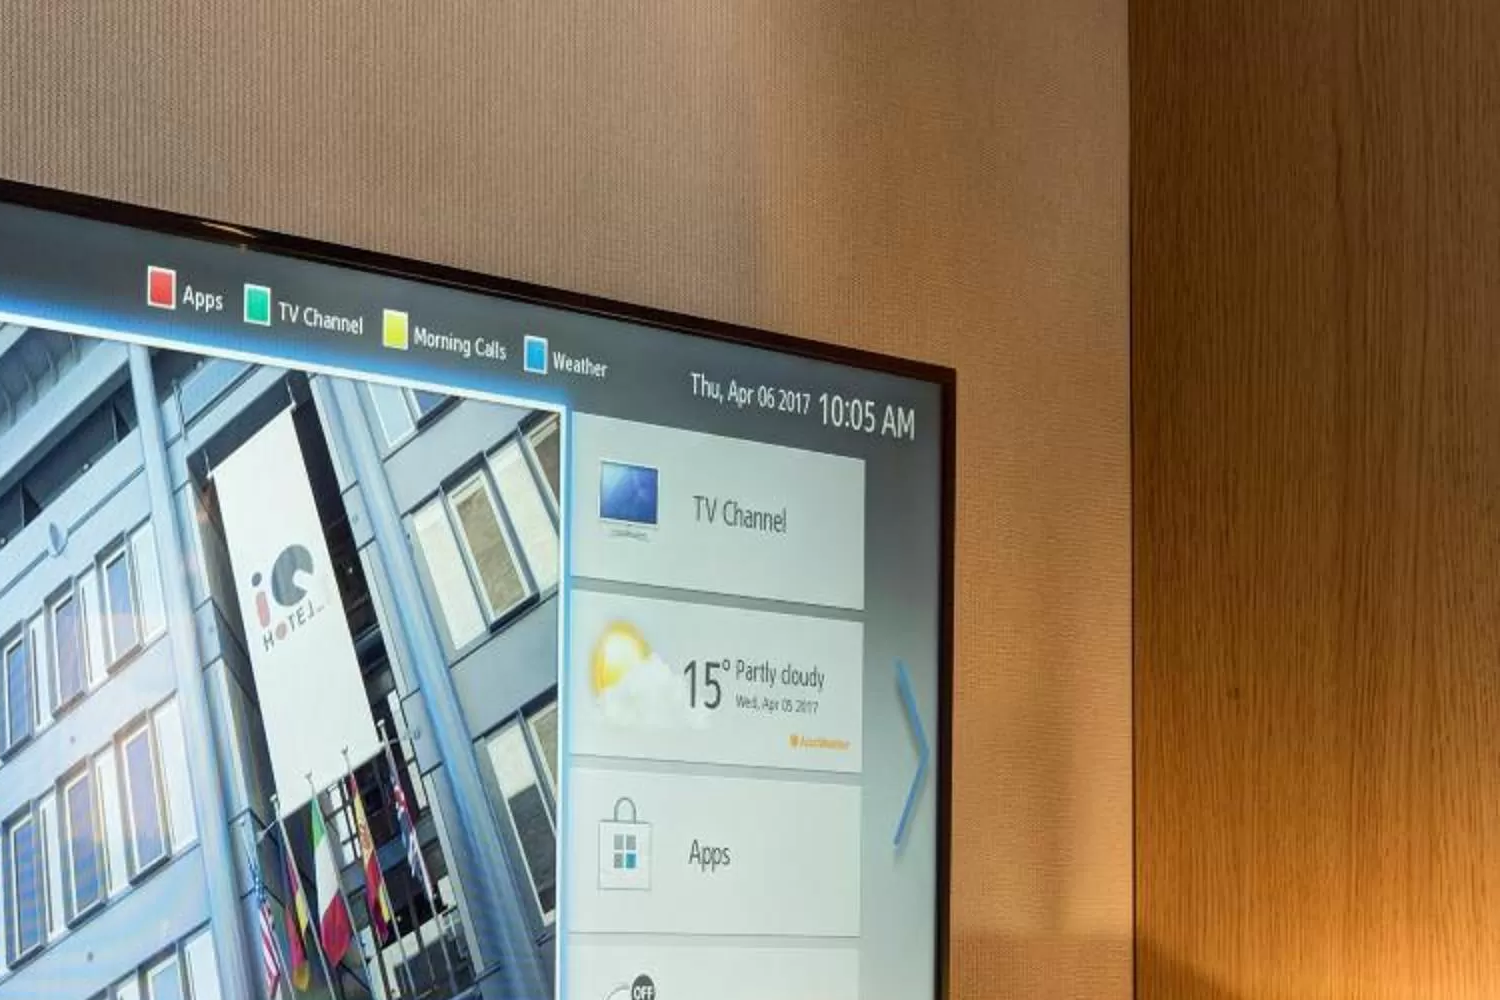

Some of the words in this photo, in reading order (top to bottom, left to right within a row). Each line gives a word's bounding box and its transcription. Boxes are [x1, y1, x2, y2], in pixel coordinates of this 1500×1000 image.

[182, 284, 223, 313] Apps
[278, 301, 299, 324] TV
[303, 306, 363, 336] Channel
[413, 326, 471, 359] Morning
[475, 338, 507, 362] Calls
[552, 351, 608, 378] Weather
[691, 372, 723, 405] Thu,
[727, 382, 754, 409] Apr
[758, 385, 775, 409] 06
[778, 388, 811, 416] 2017
[818, 393, 875, 434] 10:05
[881, 405, 916, 441] AM
[692, 495, 717, 525] TV
[723, 500, 788, 534] Channel
[735, 658, 777, 689] Partly
[781, 663, 825, 694] cloudy
[687, 838, 731, 873] Apps
[633, 984, 654, 1000] OFF
